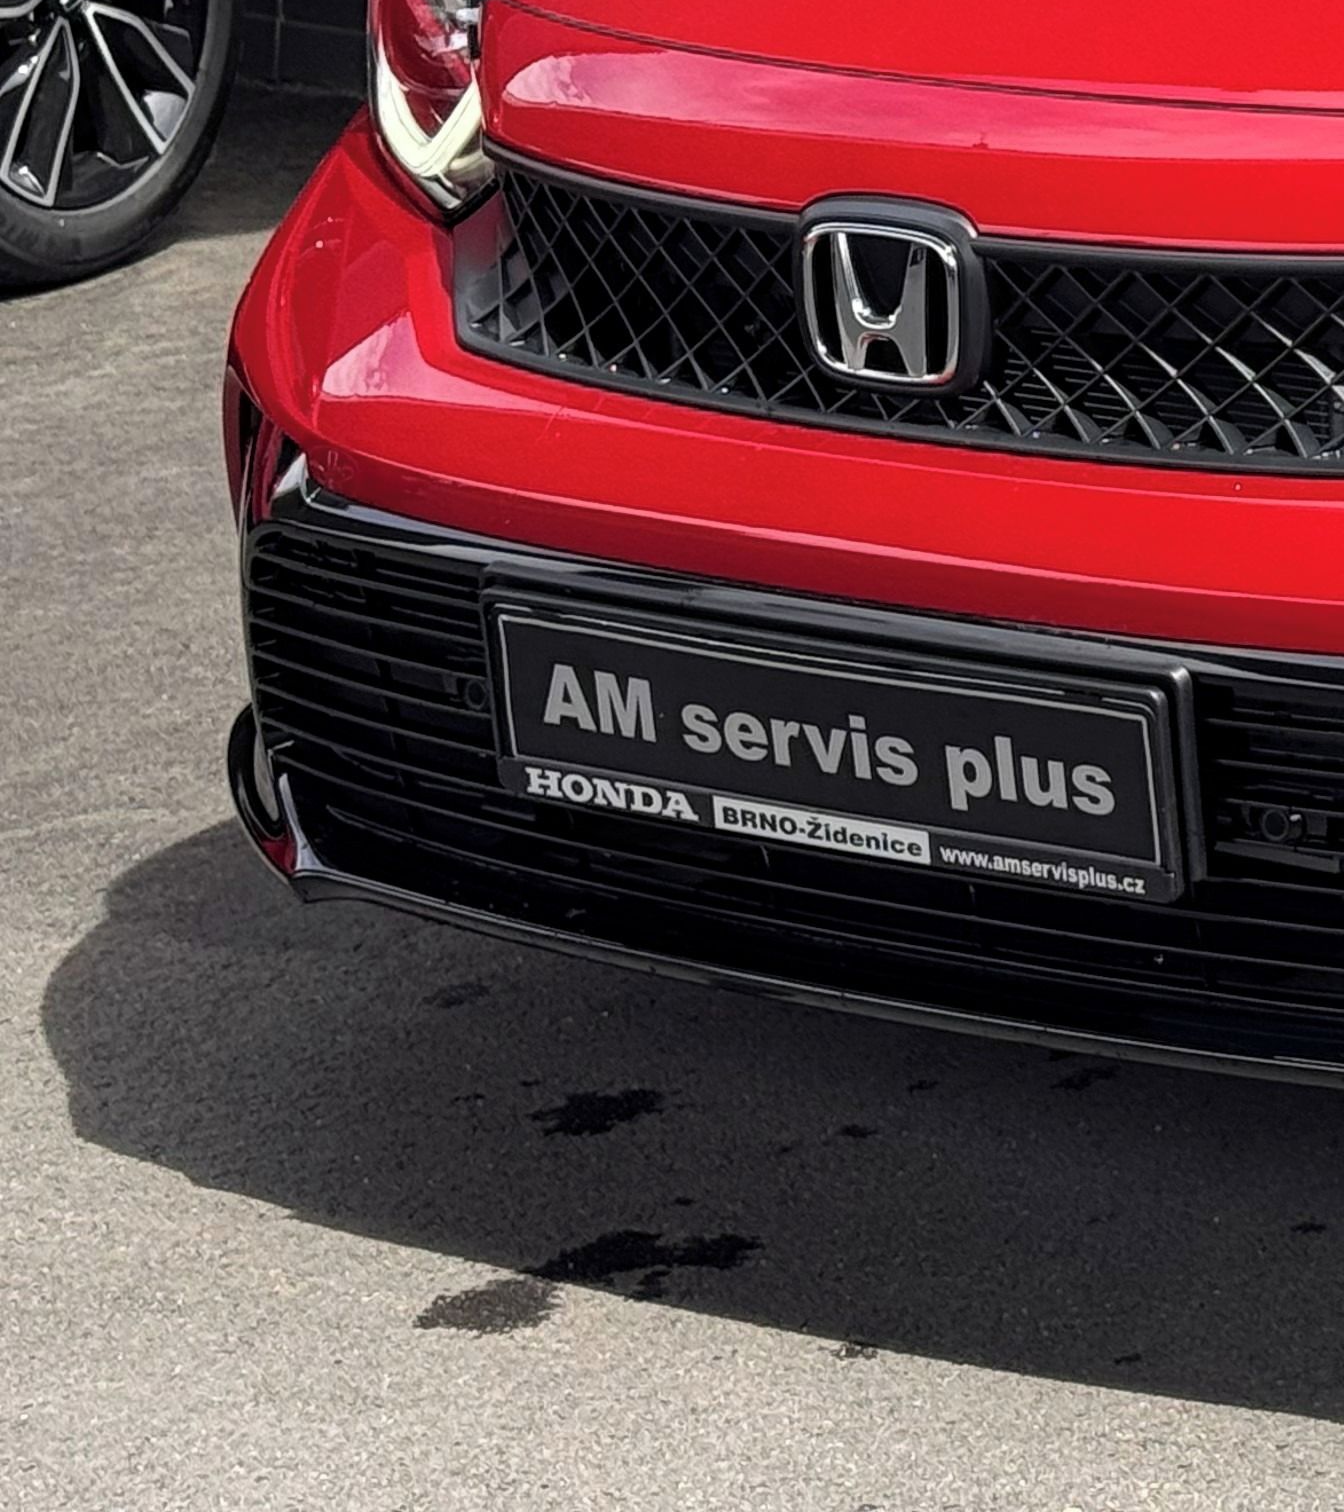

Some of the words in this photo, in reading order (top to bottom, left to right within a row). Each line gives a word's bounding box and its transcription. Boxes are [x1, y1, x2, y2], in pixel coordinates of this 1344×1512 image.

[543, 662, 657, 743] AM
[680, 702, 919, 787] servis
[944, 734, 1116, 816] plus
[524, 766, 700, 822] HONDA
[722, 805, 923, 858] BRNO-Židenice
[939, 844, 1147, 895] www.amservisplus.cz
